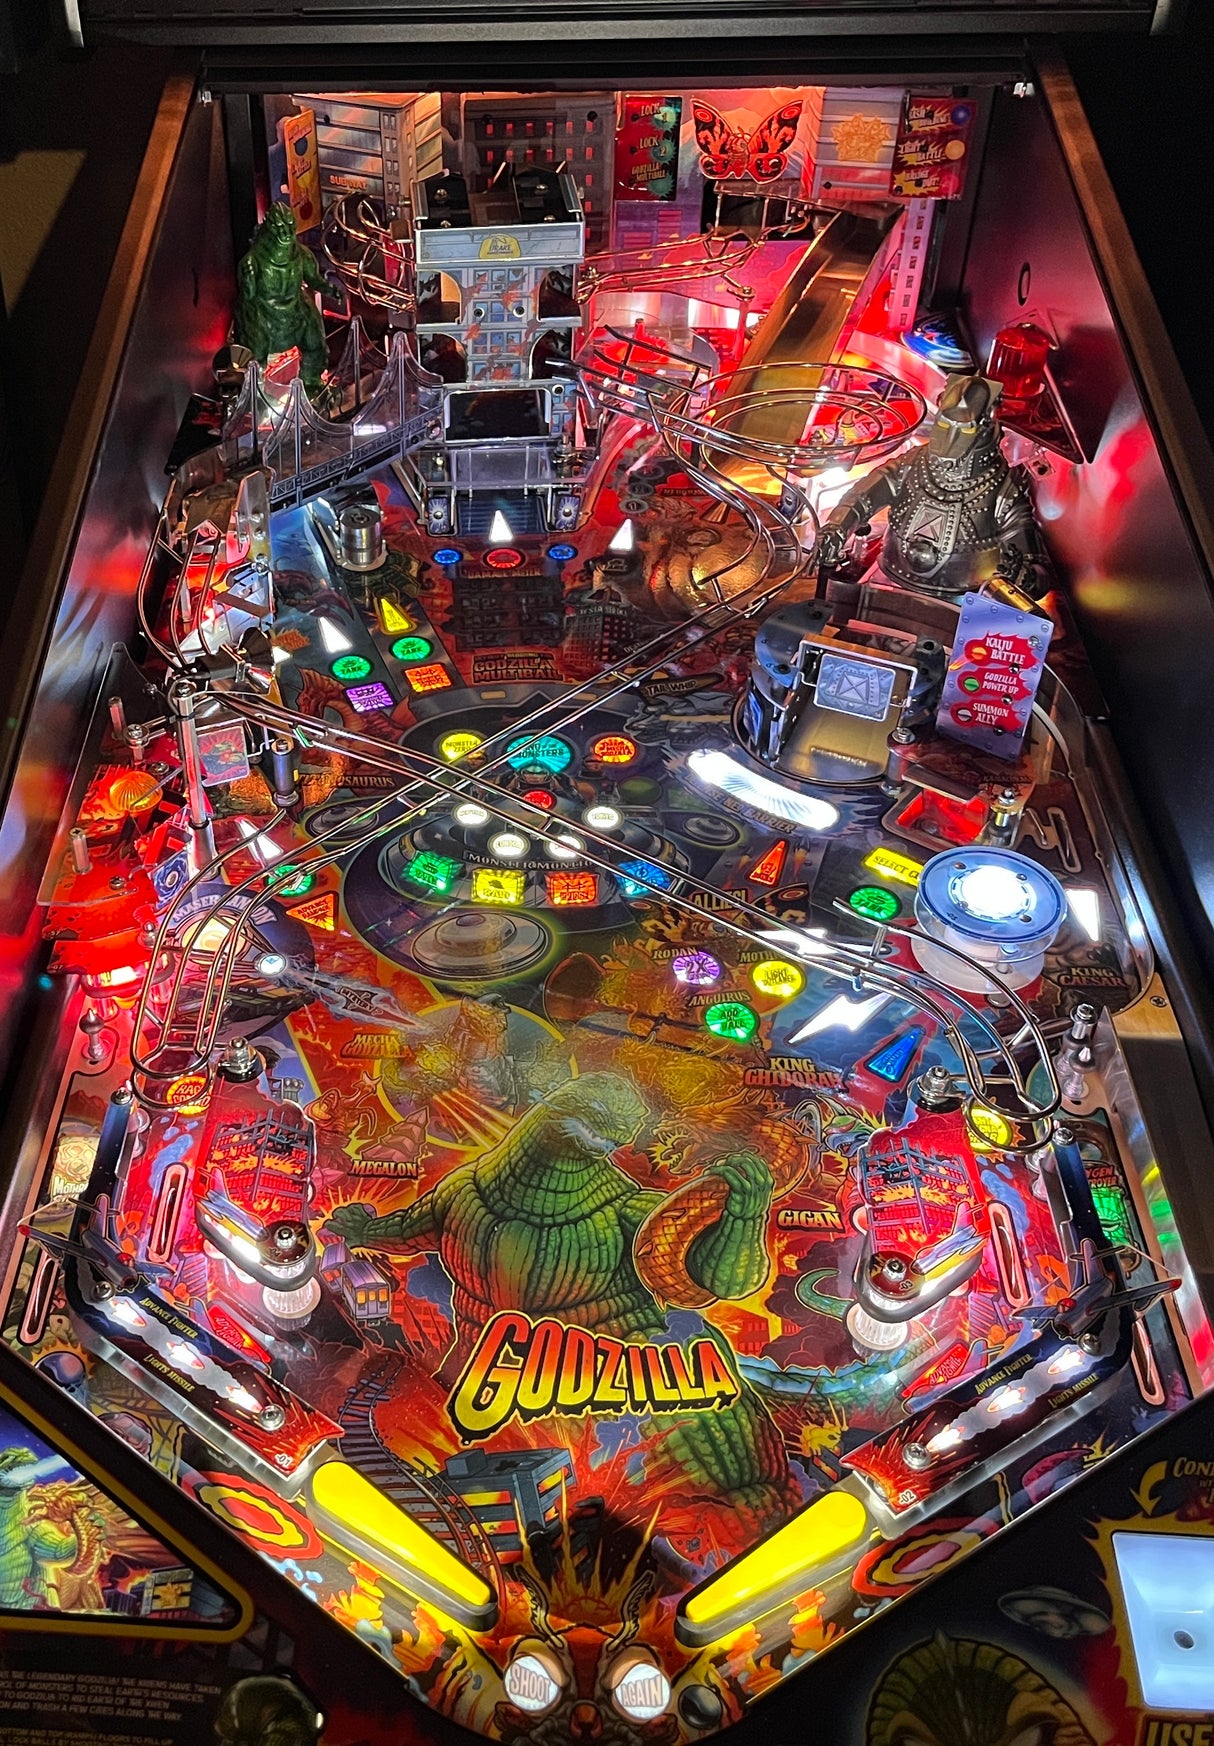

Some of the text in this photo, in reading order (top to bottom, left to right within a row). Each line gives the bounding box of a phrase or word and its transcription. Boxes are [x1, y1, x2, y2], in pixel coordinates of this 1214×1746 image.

[641, 103, 660, 117] LOCK
[640, 136, 659, 149] LOCK
[329, 174, 368, 190] SUBWAY
[986, 636, 1013, 651] KAIJU
[474, 658, 552, 672] GODZILA
[990, 650, 1025, 665] BATTLE
[984, 671, 1018, 686] GODZILLA
[647, 680, 697, 696] TAIL WHIP
[982, 680, 1019, 695] POWER UP
[973, 702, 1009, 717] SUMMON
[975, 713, 999, 725] ALLY
[743, 807, 796, 833] BARRIER
[873, 855, 909, 875] SELECT
[173, 894, 220, 922] MASER
[654, 948, 698, 959] RODAN
[1070, 967, 1114, 978] KING
[1060, 974, 1127, 987] CAESAR
[689, 991, 751, 1007] ANGUIRUS
[769, 1057, 815, 1072] KING
[744, 1069, 846, 1089] GHIDORAH
[351, 1160, 417, 1177] MEGALON
[778, 1209, 841, 1230] GIGAN
[140, 1296, 199, 1339] ADVANCE FIGHTER
[143, 1353, 196, 1393] LIGHTS MISSILE
[451, 1311, 740, 1436] GODZILLA
[974, 1353, 1033, 1395] ADVANCE FIGHTER
[275, 1454, 292, 1467] -01
[899, 1489, 918, 1506] -02
[76, 1684, 88, 1693] TO
[89, 1684, 113, 1695] STEAL
[510, 1662, 664, 1708] SHOOT AGAIN
[59, 1693, 70, 1702] TO
